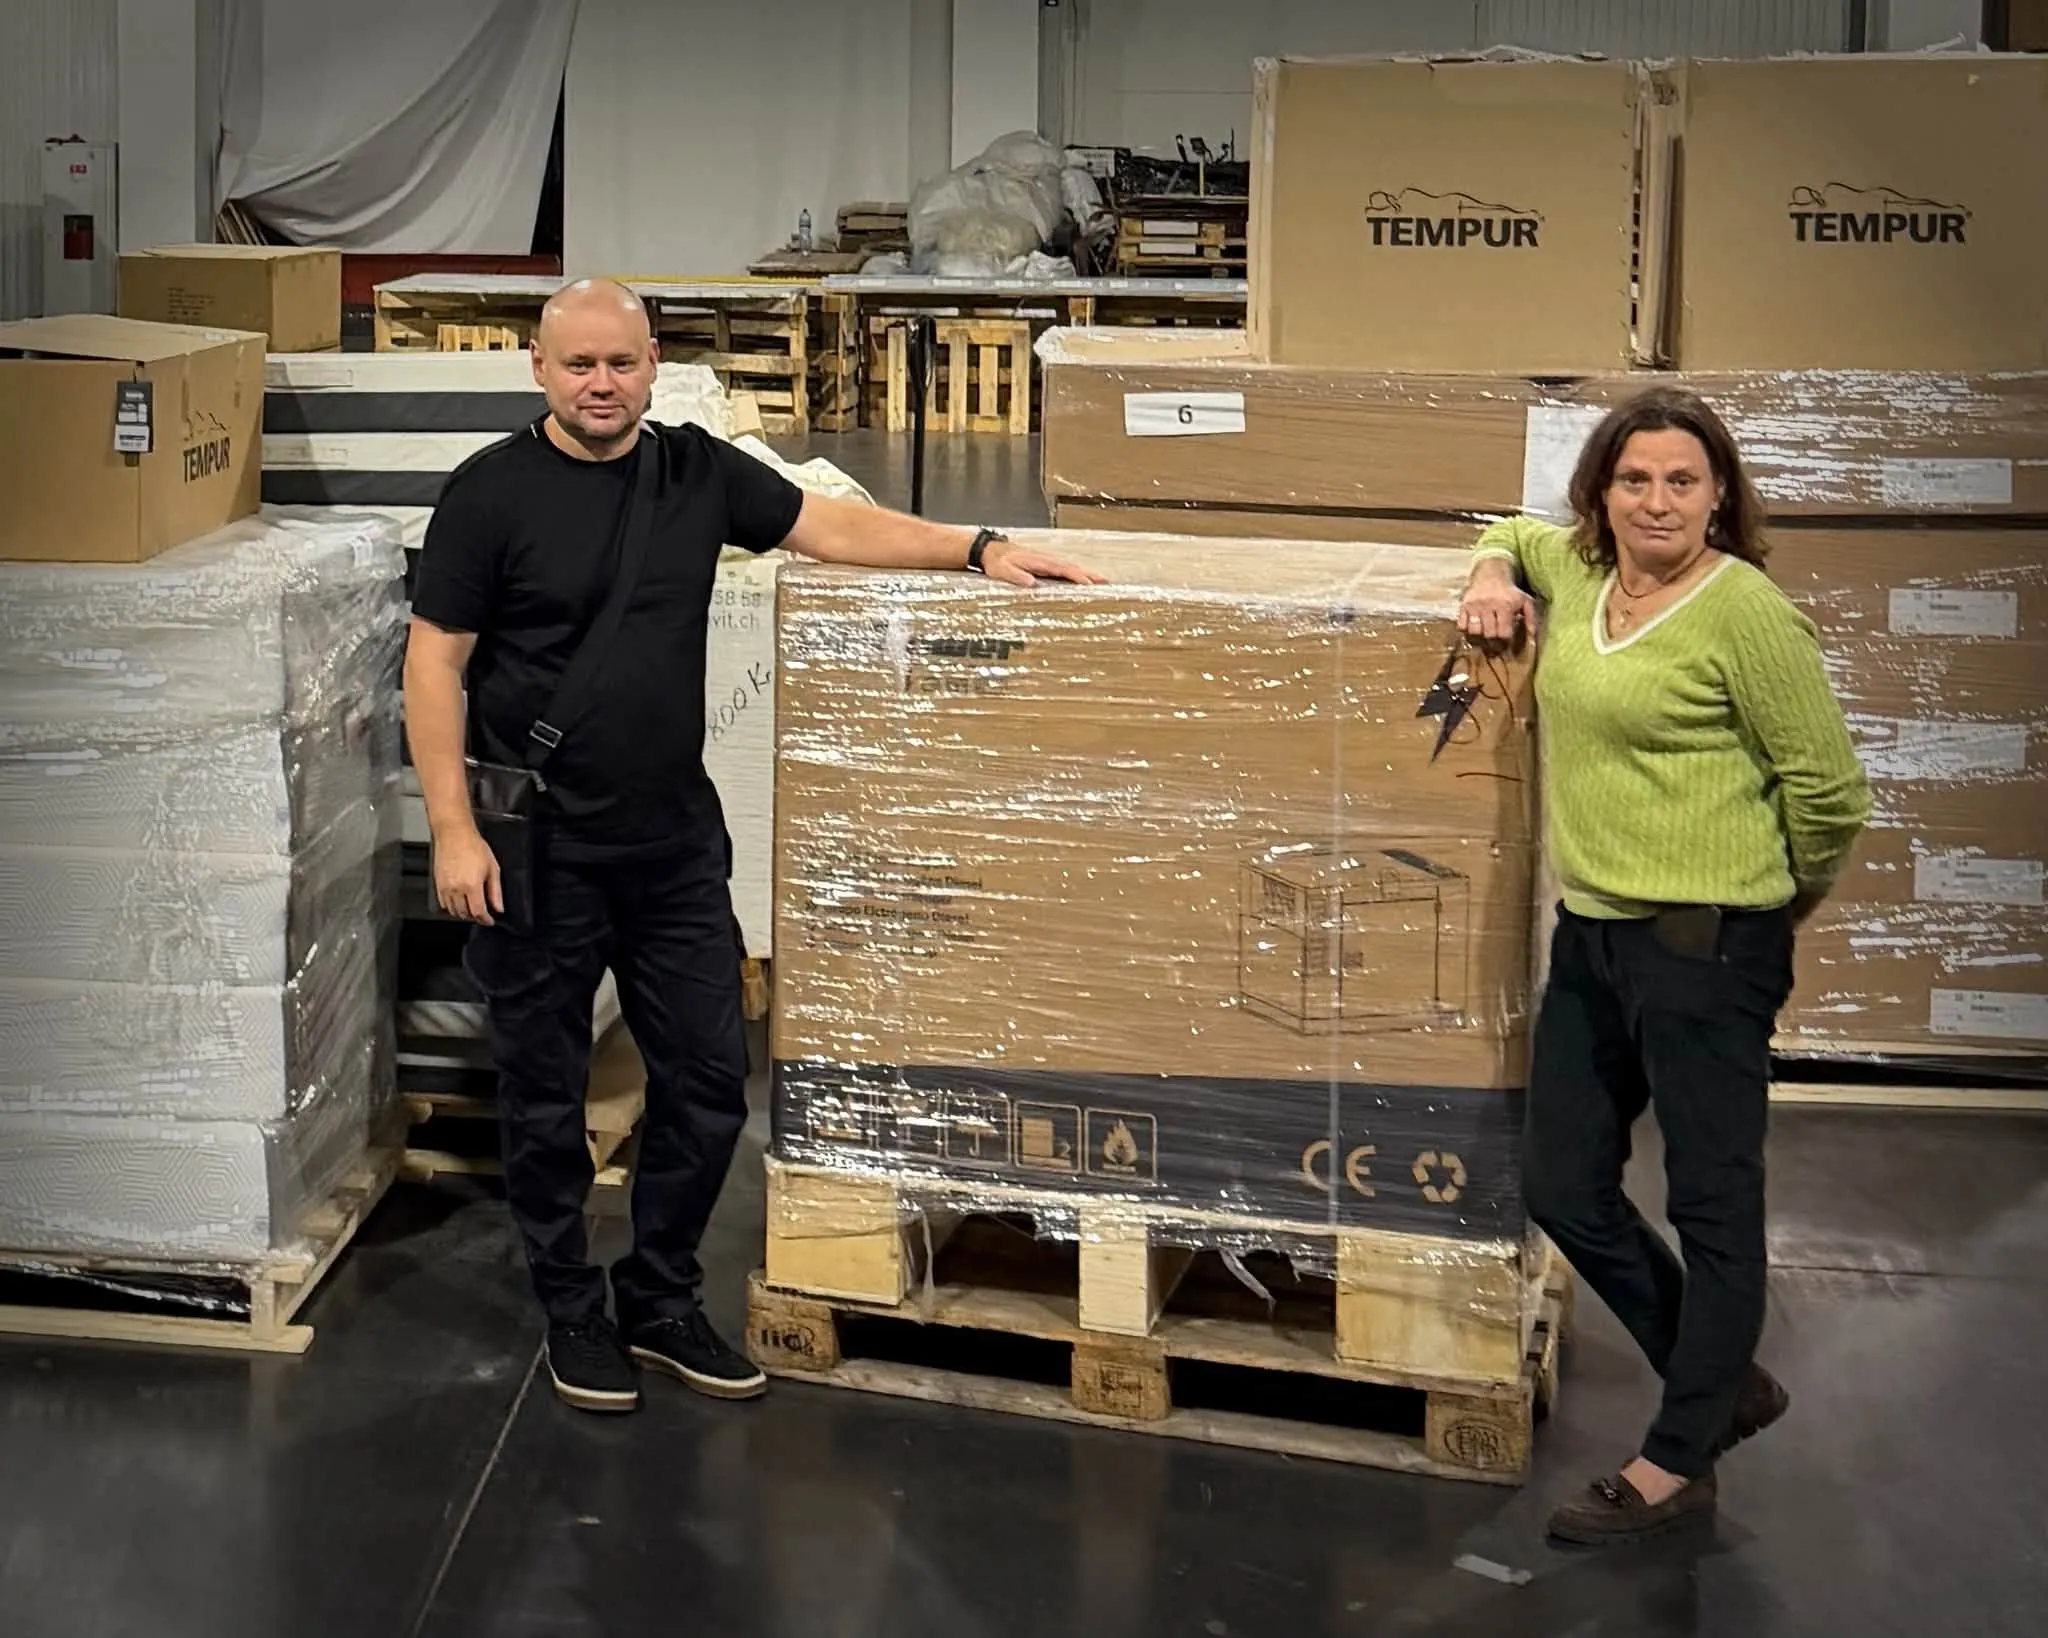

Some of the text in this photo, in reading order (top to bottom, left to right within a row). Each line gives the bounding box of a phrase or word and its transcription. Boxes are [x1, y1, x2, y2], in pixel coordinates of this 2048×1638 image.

[1366, 216, 1539, 248] TEMPUR
[1789, 211, 1967, 243] TEMPUR
[1178, 404, 1193, 425] 6
[182, 436, 231, 484] TEMPUR
